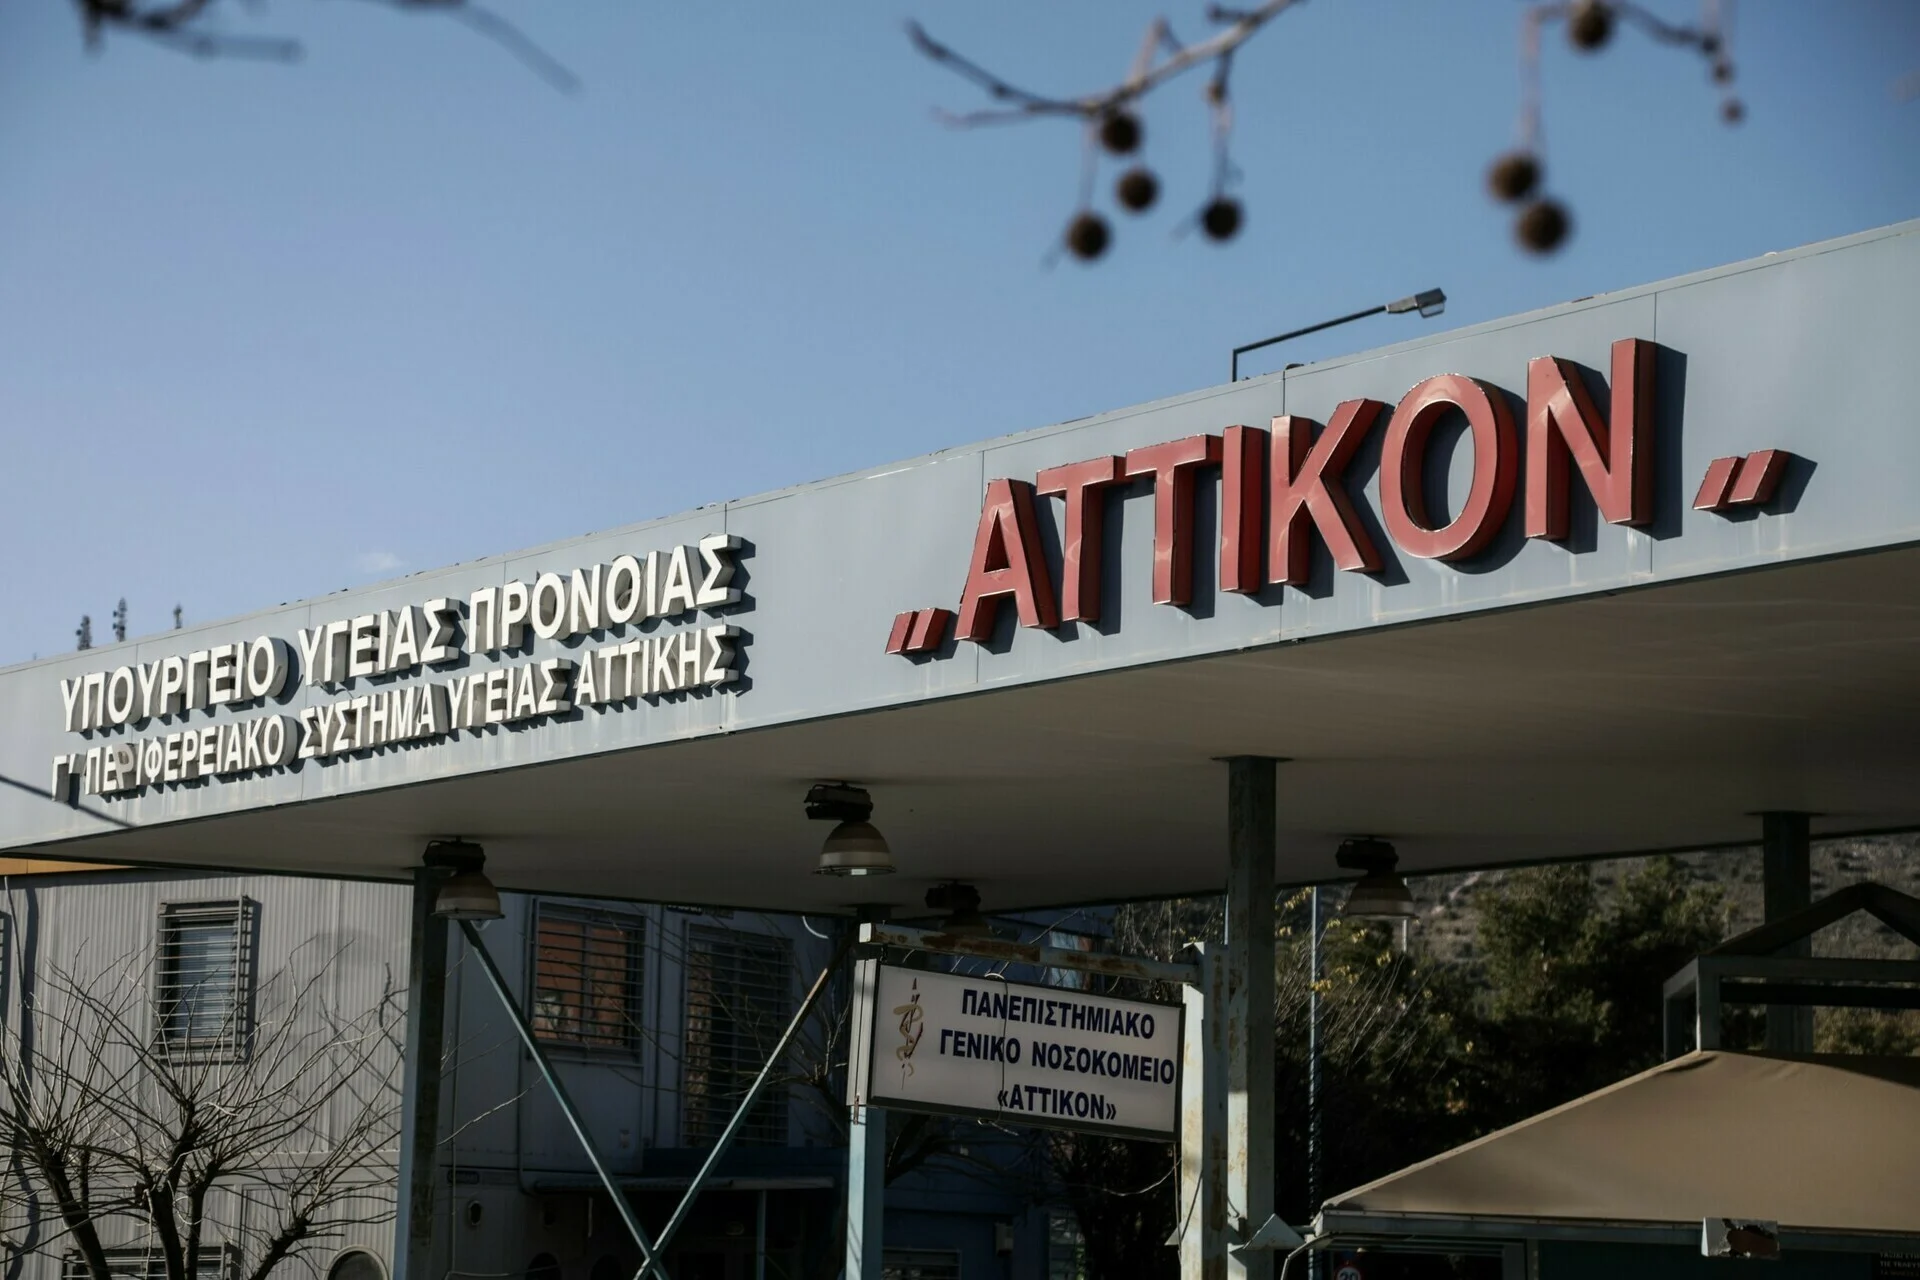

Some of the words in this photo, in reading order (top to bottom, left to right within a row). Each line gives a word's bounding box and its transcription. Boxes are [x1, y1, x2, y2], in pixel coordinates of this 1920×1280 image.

[60, 635, 288, 732] ΥΠΟΥΡΓΕΙΟ
[298, 597, 460, 687] ΥΓΕΙΑΣ
[468, 533, 742, 654] ΠΡΟΝΟΙΑΣ
[85, 714, 298, 795] ΠΕΡΙΦΕΡΕΙΑΚΟ
[299, 682, 448, 759] ΣΥΣΤΗΜΑ
[448, 657, 572, 730] ΥΓΕΙΑΣ
[574, 623, 739, 706] ΑΤΤΙΚΗΣ
[961, 988, 1155, 1040] ΠΑΝΕΠΙΣΤΗΜΙΑΚΟ
[939, 1028, 1021, 1064] ΓΕΝΙΚΟ
[1031, 1040, 1175, 1085] ΝΟΣΟΚΟΜΕΙΟ
[997, 1083, 1117, 1121] «ΑΤΤΙΚΟΝ»
